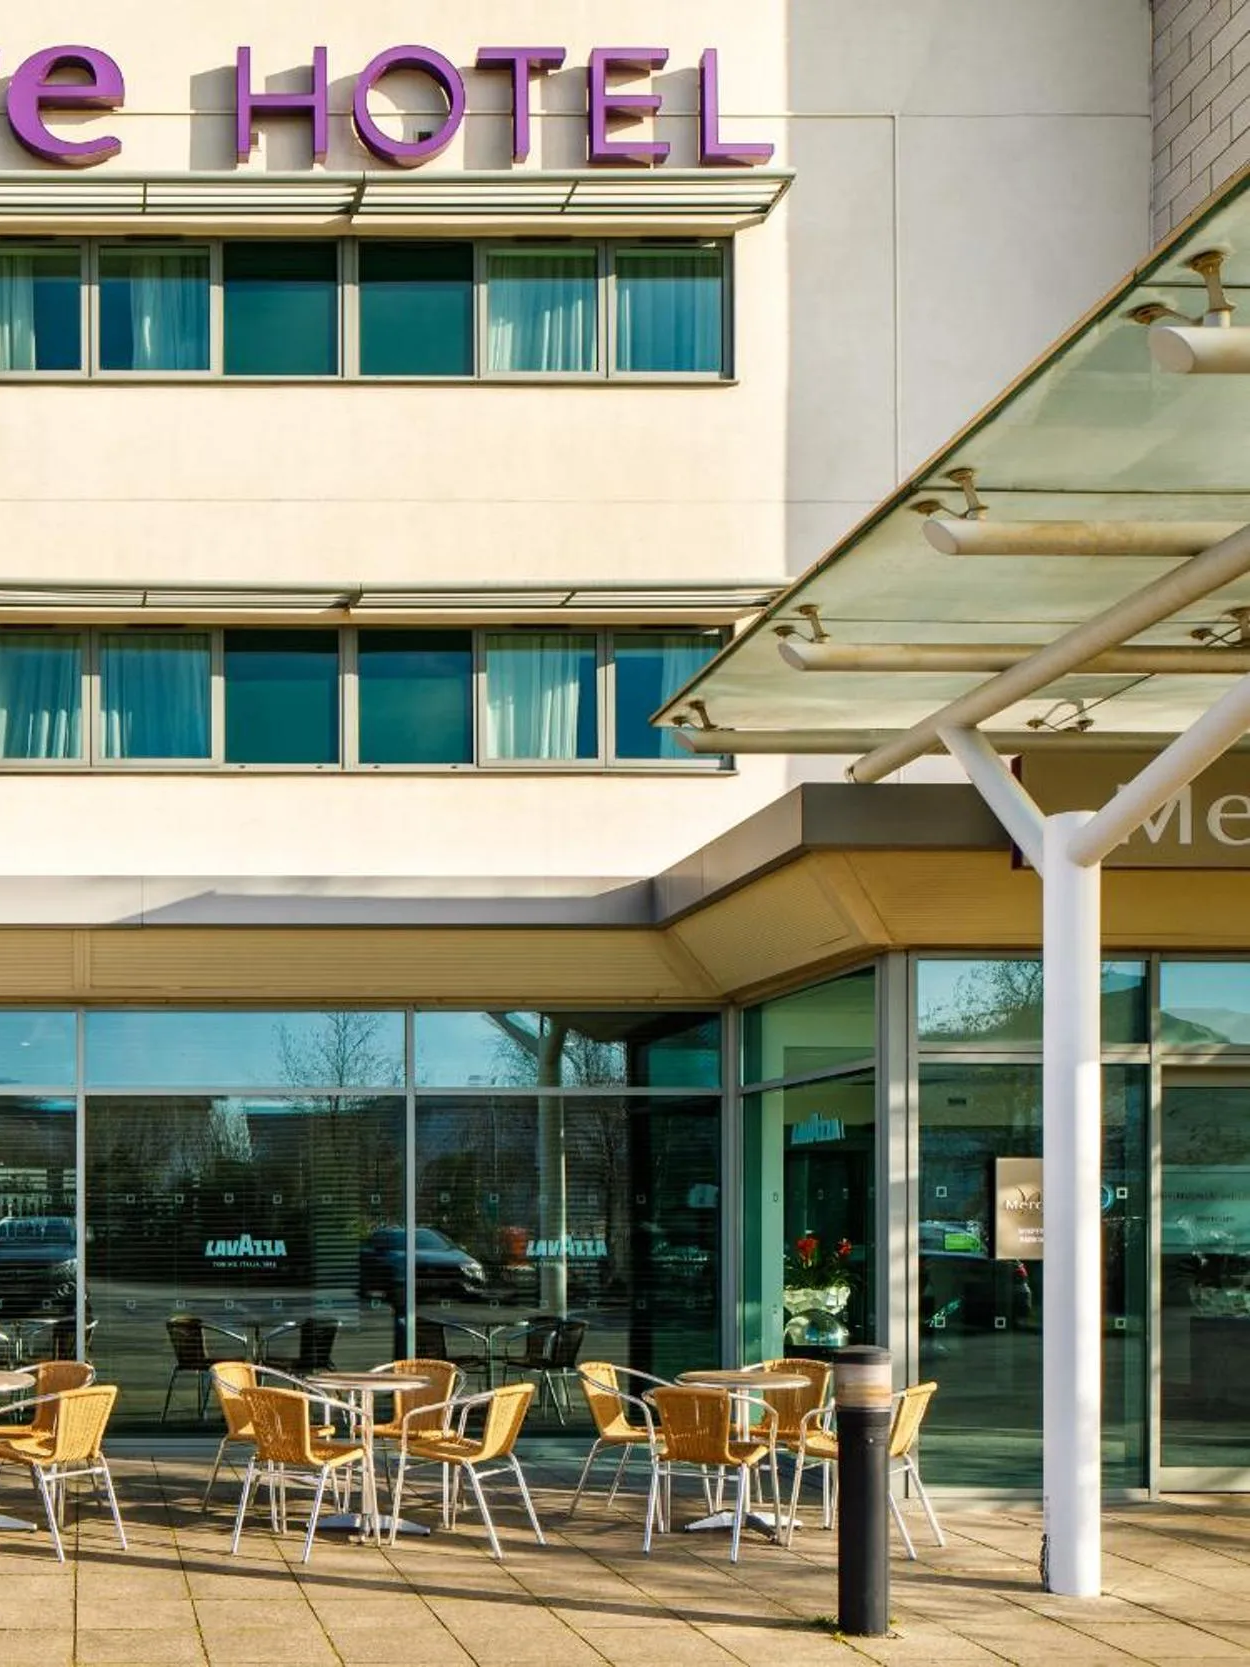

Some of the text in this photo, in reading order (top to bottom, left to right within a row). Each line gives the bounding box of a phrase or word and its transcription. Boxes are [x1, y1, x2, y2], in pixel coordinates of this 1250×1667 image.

[234, 44, 775, 167] HOTEL
[205, 1233, 287, 1256] LAVAZZA
[526, 1235, 608, 1256] LAVAZZA
